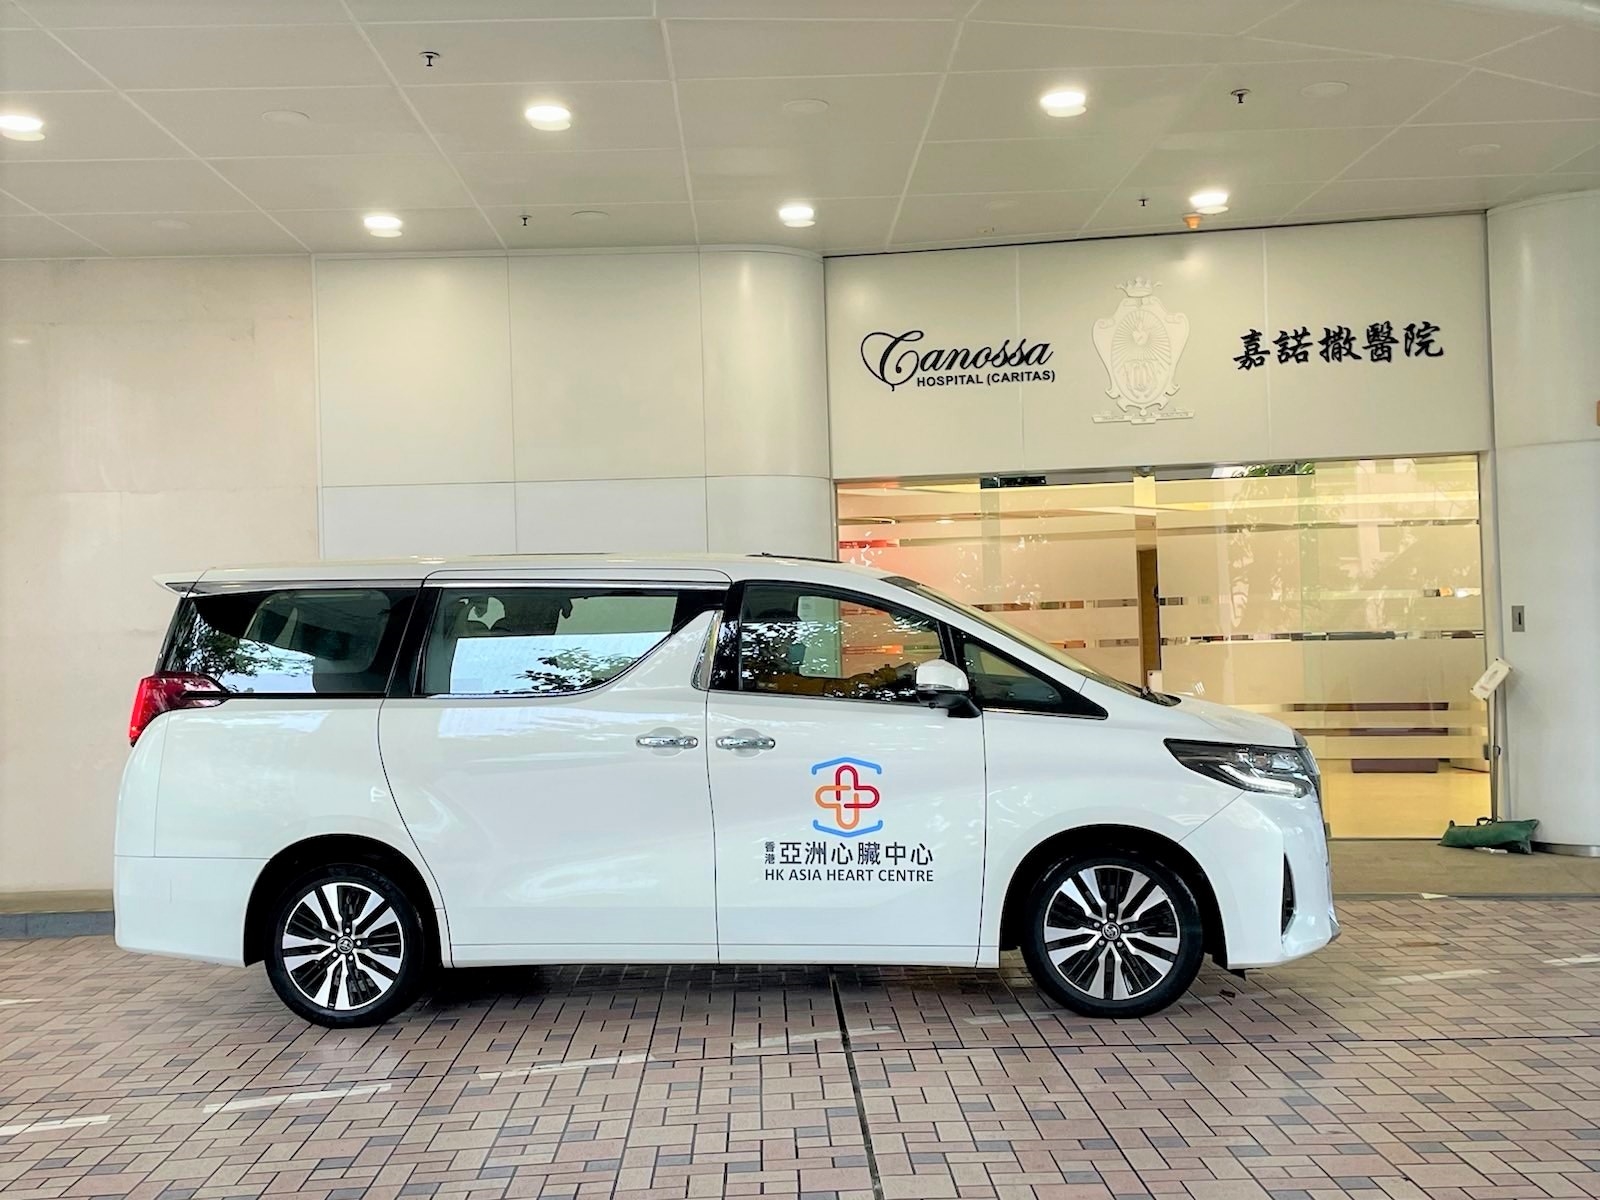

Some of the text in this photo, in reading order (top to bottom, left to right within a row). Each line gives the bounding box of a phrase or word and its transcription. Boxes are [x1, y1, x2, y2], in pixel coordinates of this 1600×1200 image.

[1233, 320, 1444, 371] 嘉諾撒醫院
[861, 330, 1054, 391] Canossa
[916, 370, 1056, 387] HOSPITAL (CARITAS)
[764, 841, 776, 865] 香港
[765, 869, 934, 882] HK ASIA HEART CENTRE
